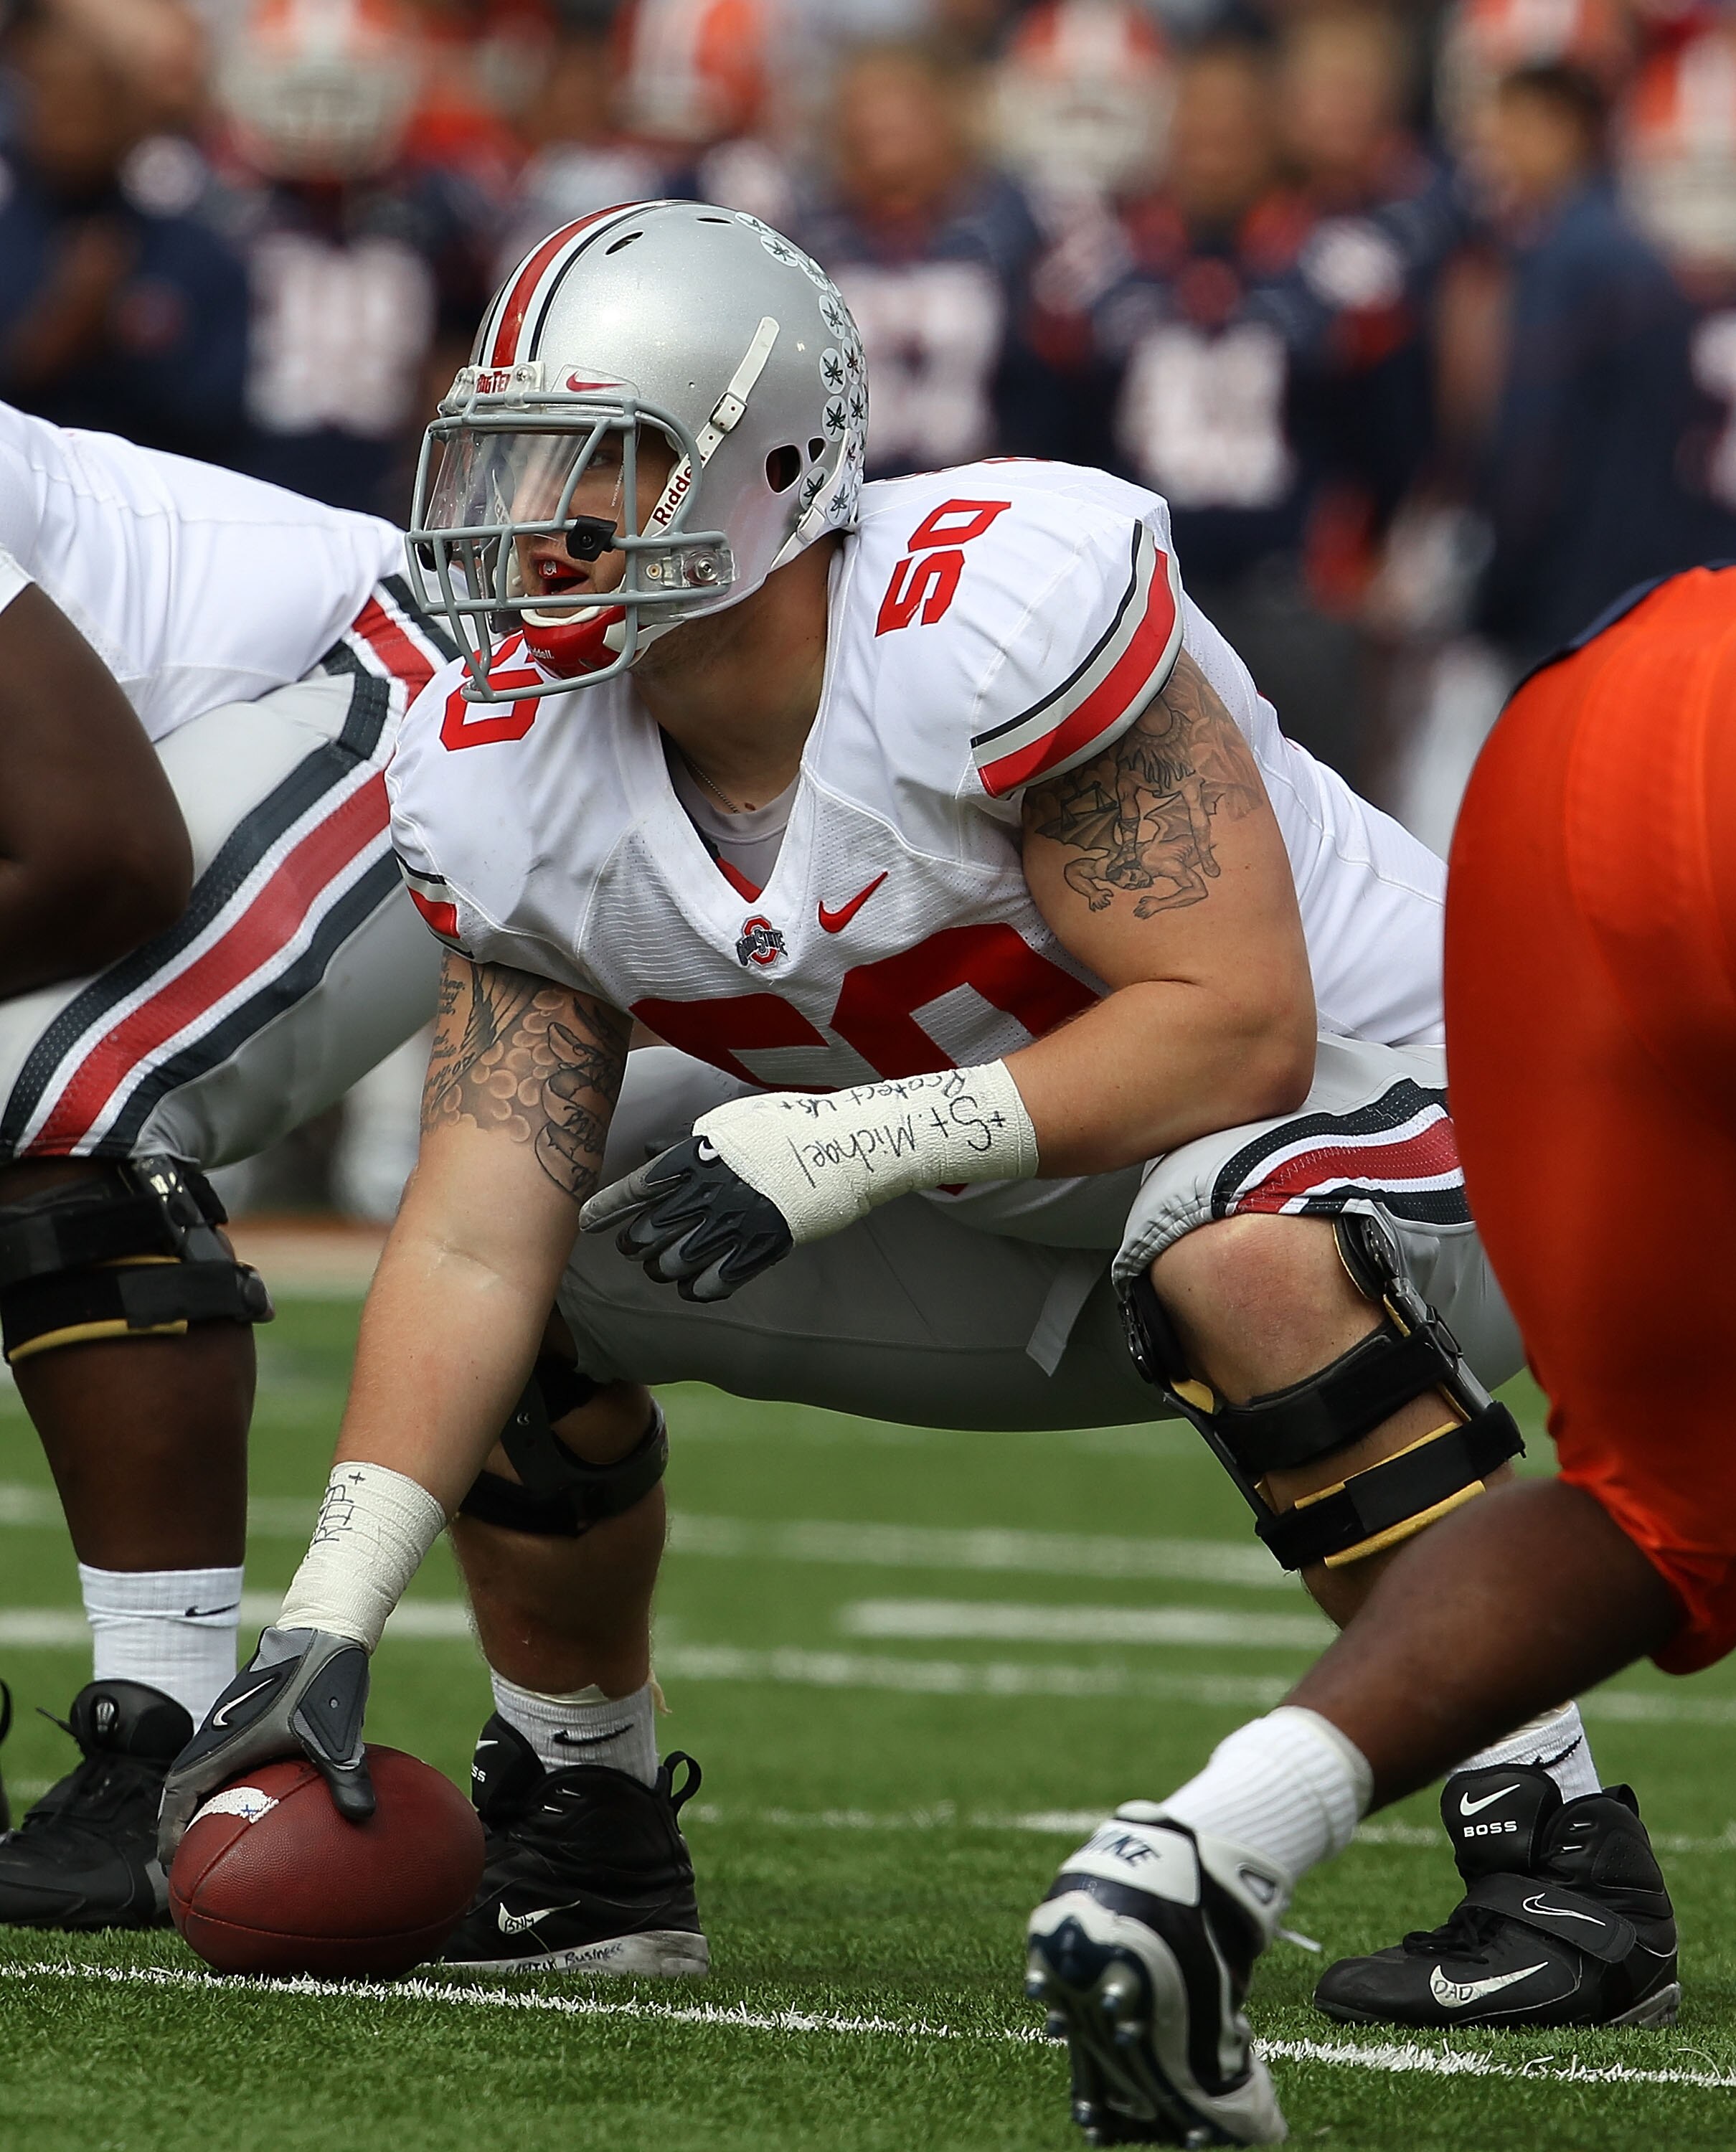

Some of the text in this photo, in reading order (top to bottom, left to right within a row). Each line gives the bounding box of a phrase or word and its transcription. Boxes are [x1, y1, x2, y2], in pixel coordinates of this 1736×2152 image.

[652, 455, 706, 526] Ridde
[875, 499, 1011, 638] 50
[788, 1114, 915, 1189] Michael
[471, 1762, 486, 1783] SS
[1463, 1821, 1517, 1838] BOSS
[1434, 1978, 1475, 2001] DAD
